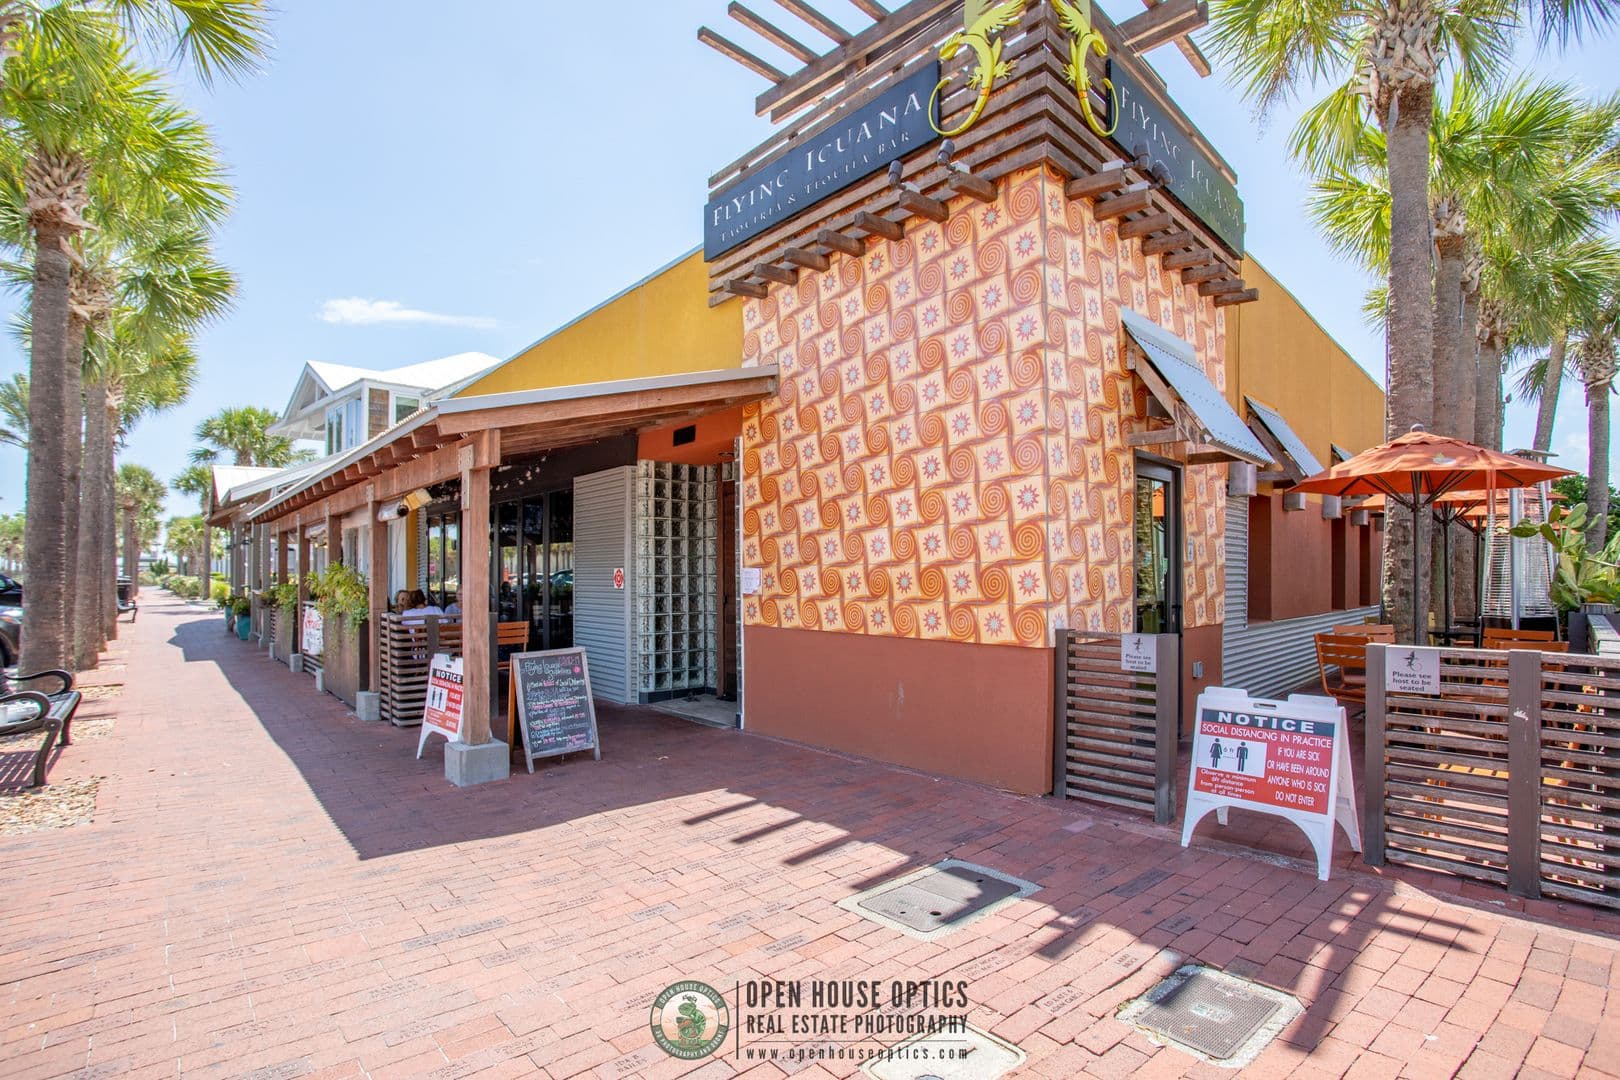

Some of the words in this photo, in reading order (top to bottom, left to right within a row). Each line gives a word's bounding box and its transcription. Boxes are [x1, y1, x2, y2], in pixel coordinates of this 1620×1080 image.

[878, 131, 910, 155] BAR
[712, 168, 789, 227] FLYING
[806, 93, 922, 172] IGUANA
[435, 670, 462, 684] NOTICE
[1392, 671, 1417, 679] Please
[1392, 677, 1410, 685] host
[1217, 711, 1315, 734] NOTICE
[1201, 723, 1229, 735] SOCIAL
[1231, 727, 1278, 741] DISTANCING
[1281, 733, 1290, 743] IN
[1292, 735, 1332, 749] PRACTICE
[1277, 746, 1283, 757] IF
[1283, 747, 1295, 758] YOU
[1295, 749, 1307, 760] ARE
[1307, 751, 1320, 762] SICK
[1266, 759, 1275, 769] OR
[1275, 761, 1290, 772] HAVE
[1290, 763, 1304, 774] BEEN
[1305, 766, 1330, 778] AROUND
[1267, 775, 1290, 787] ANYONE
[1291, 778, 1306, 790] WHO
[1306, 781, 1313, 791] IS
[1313, 782, 1327, 793] SICK
[1275, 790, 1285, 801] DO
[1285, 793, 1298, 803] NOT
[1298, 794, 1315, 807] ENTER
